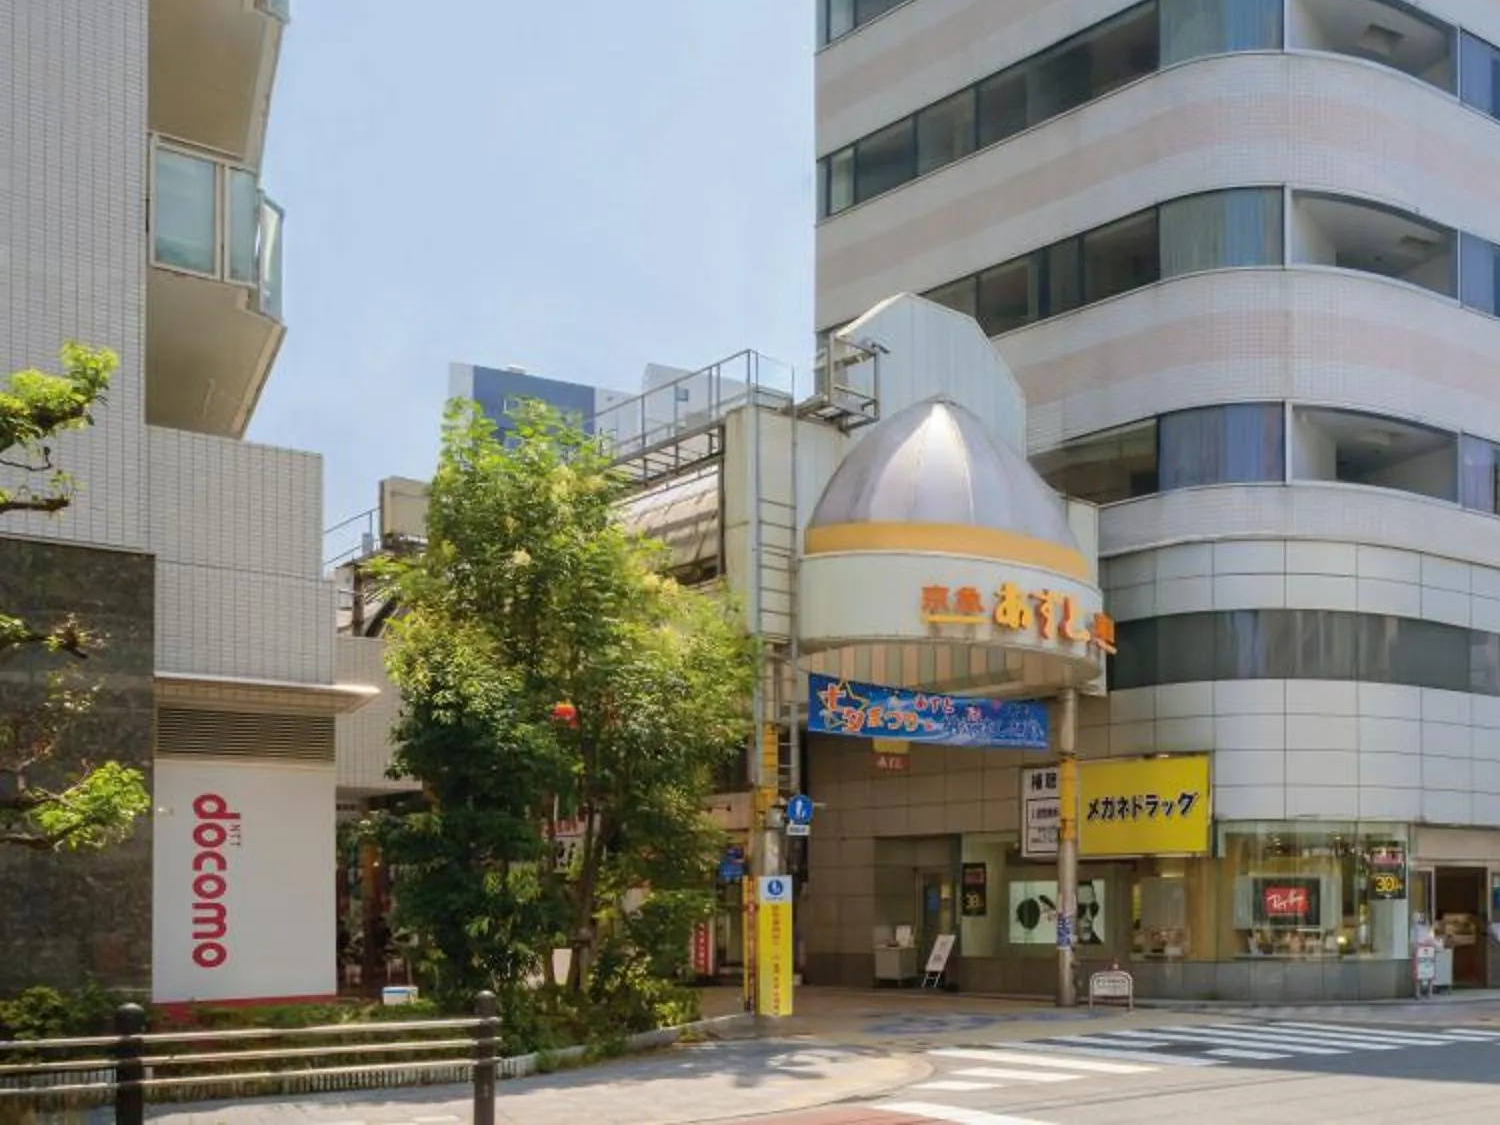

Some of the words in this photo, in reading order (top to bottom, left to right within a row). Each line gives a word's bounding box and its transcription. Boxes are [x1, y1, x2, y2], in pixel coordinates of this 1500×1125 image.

[1087, 791, 1199, 821] メガネドラッグ
[229, 824, 241, 848] NTT
[192, 793, 241, 968] docomo
